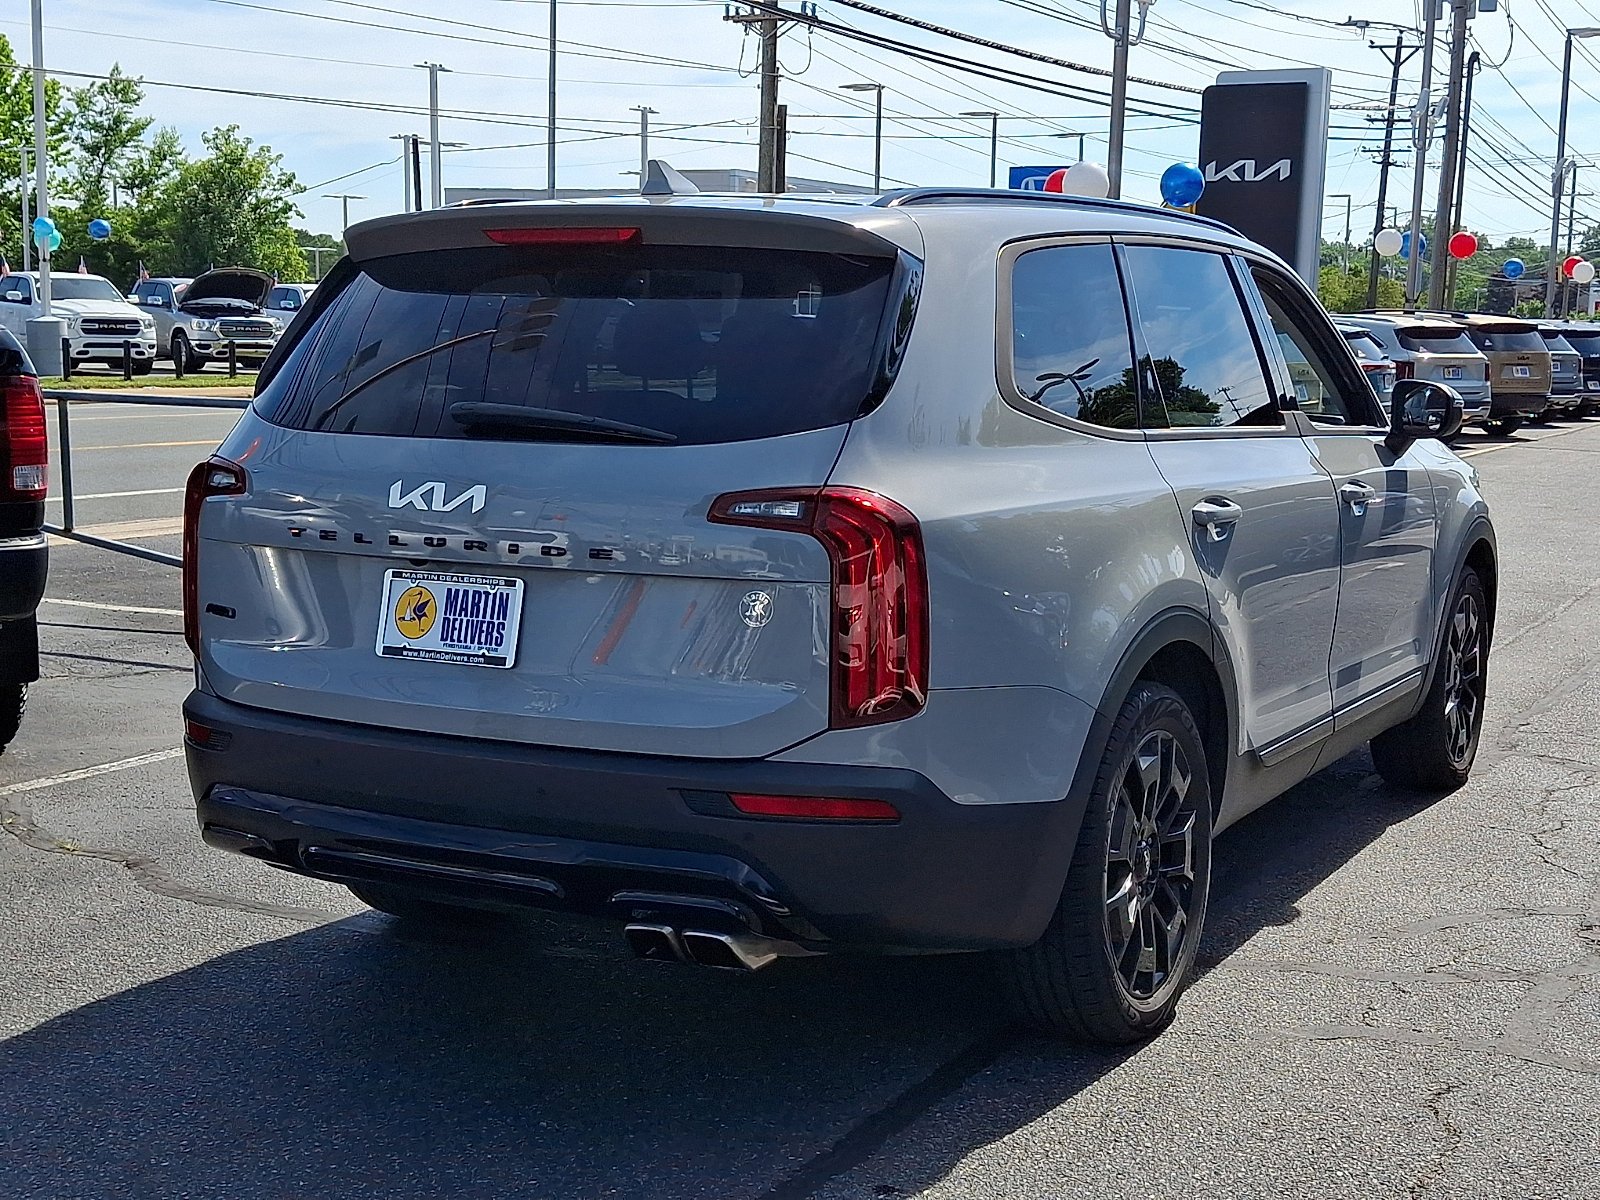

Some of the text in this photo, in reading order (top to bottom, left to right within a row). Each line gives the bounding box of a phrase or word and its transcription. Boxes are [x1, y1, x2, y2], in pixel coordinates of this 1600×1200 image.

[1205, 159, 1291, 182] KIA
[388, 479, 487, 514] KIA
[288, 527, 614, 560] TELLURIDE
[402, 572, 506, 586] MARTIN DEALERSHIPS
[444, 587, 510, 622] MARTIN
[439, 616, 506, 648] DELIVERS
[402, 649, 485, 663] www.MartinDelivers.com
